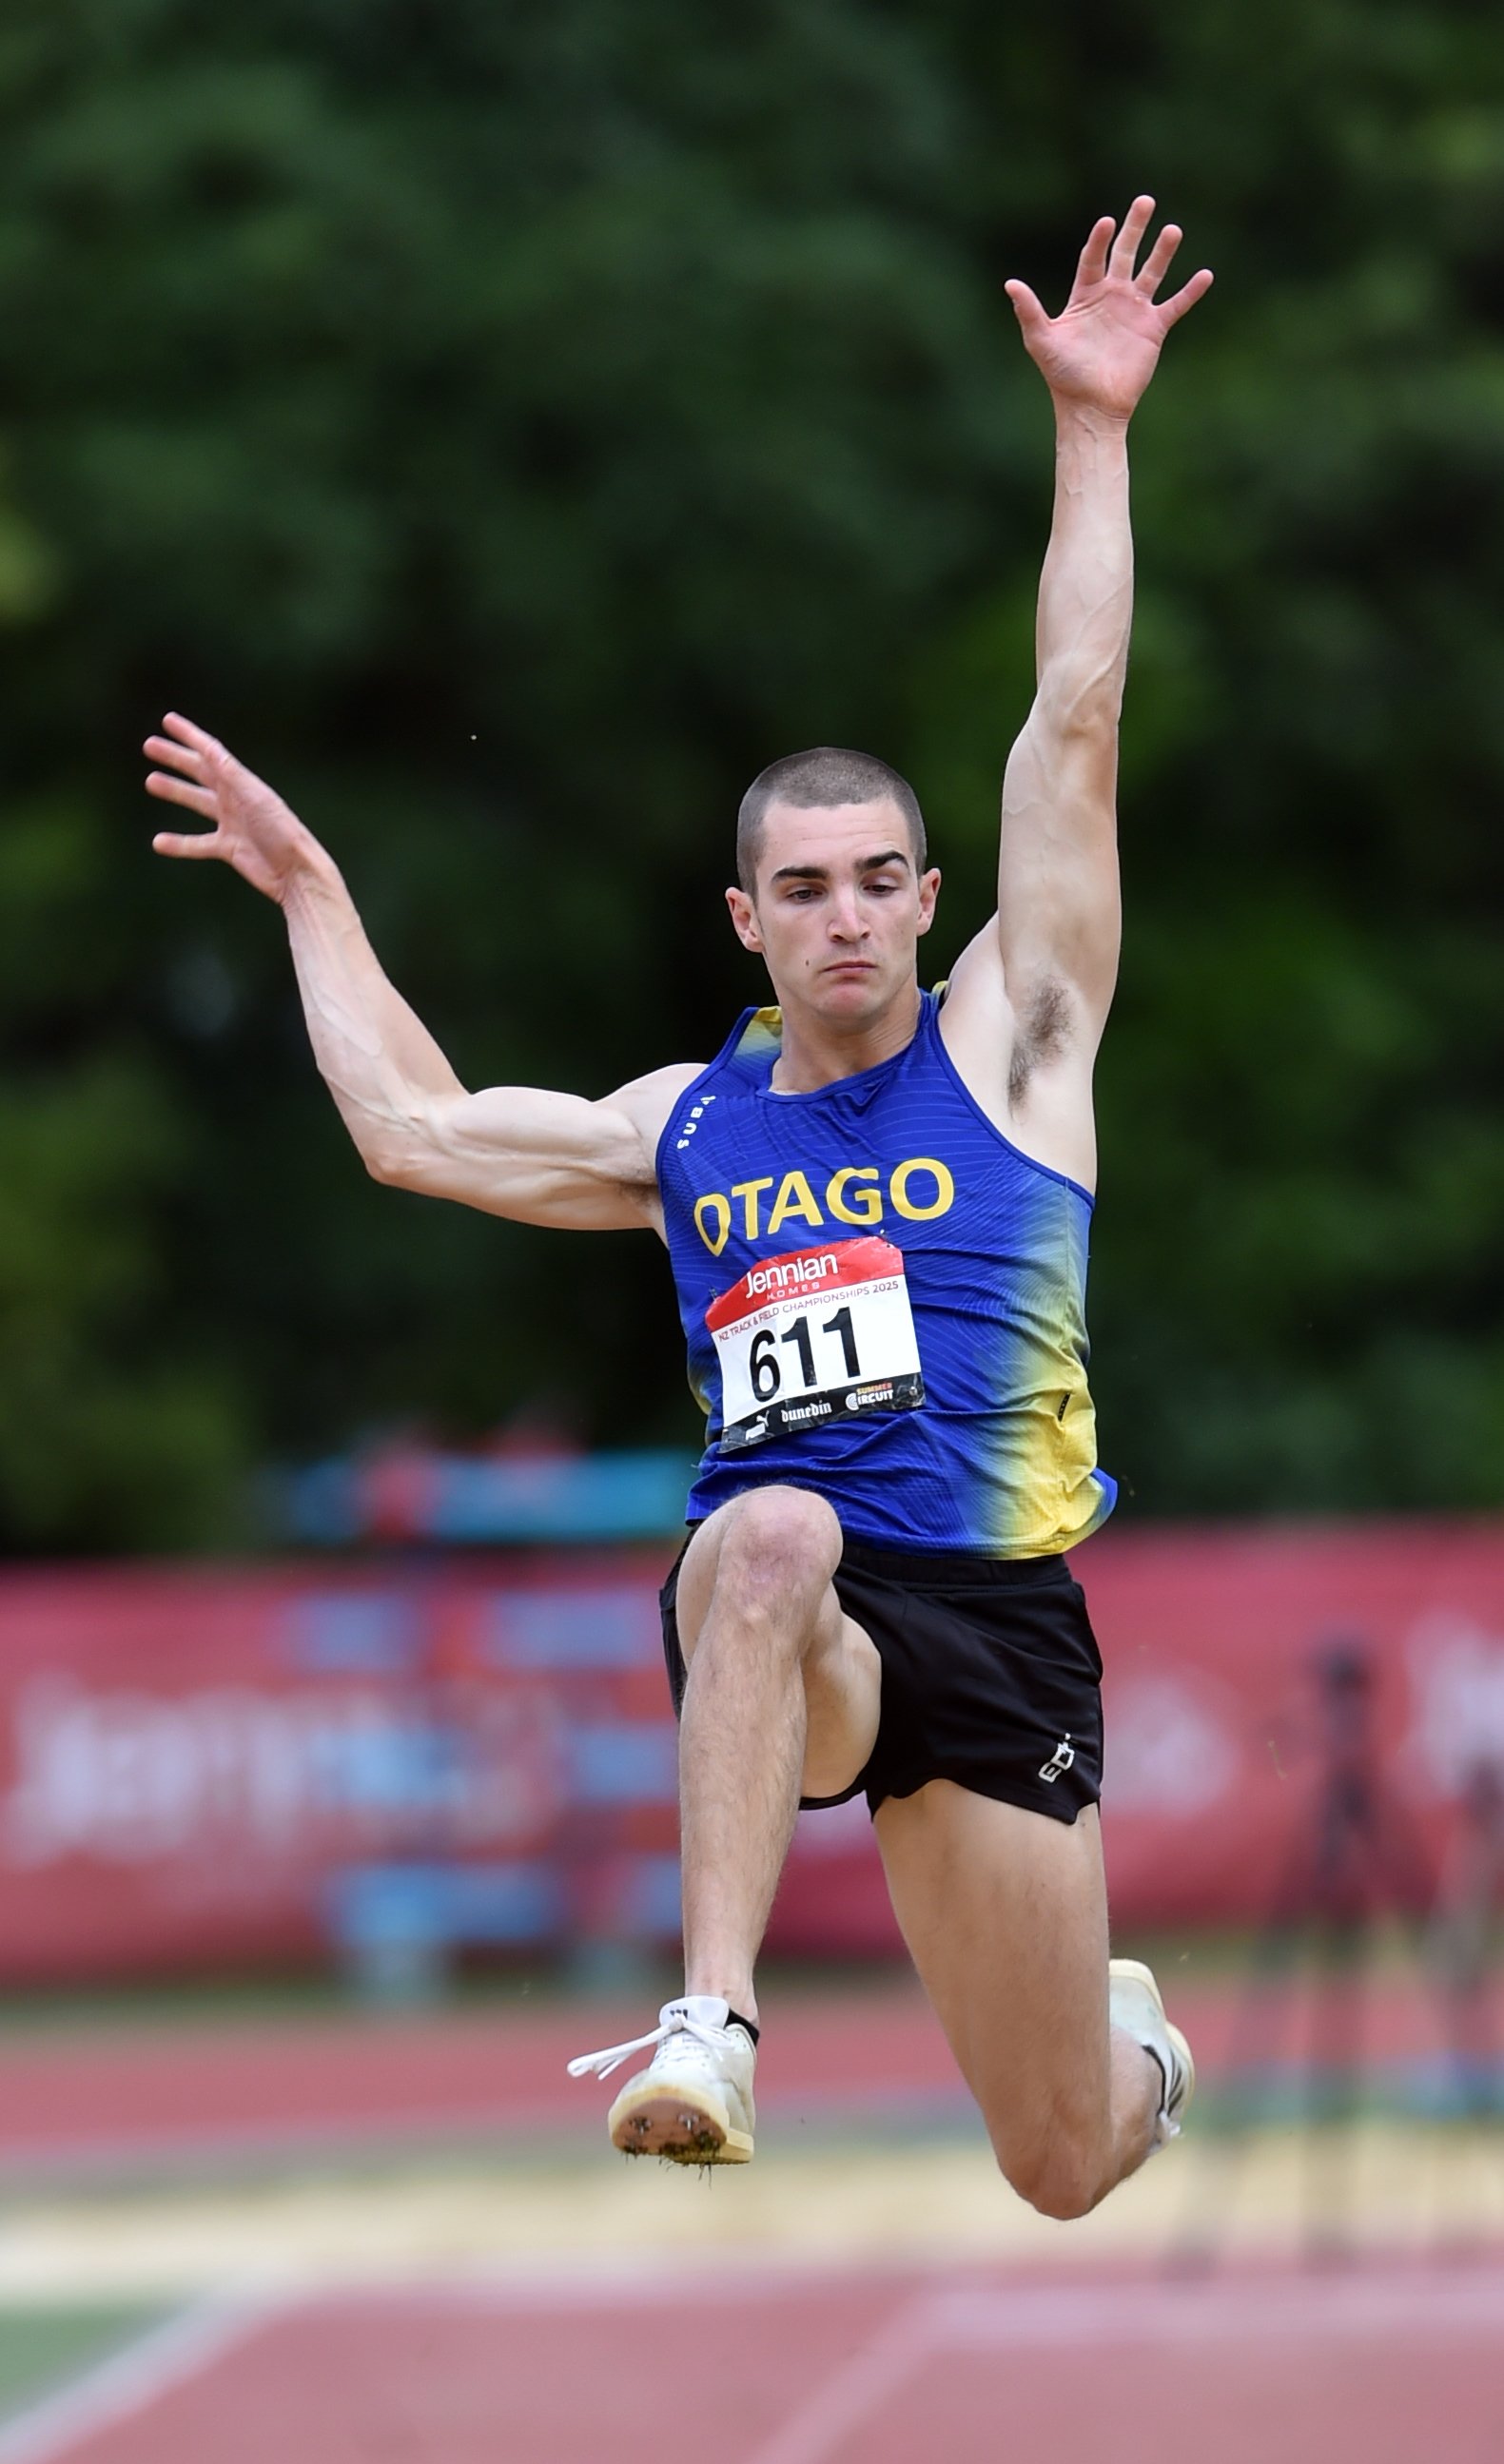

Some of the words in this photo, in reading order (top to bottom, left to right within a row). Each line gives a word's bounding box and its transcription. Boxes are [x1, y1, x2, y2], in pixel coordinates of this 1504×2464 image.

[693, 1157, 954, 1257] OTAGO
[746, 1253, 838, 1299] Jennian
[767, 1282, 820, 1300] HOMES
[730, 1320, 752, 1337] TRACK
[758, 1307, 780, 1323] FIELD
[782, 1287, 870, 1313] CHAMPIONSHIPS
[872, 1280, 899, 1294] 2025
[749, 1306, 861, 1403] 611
[780, 1399, 833, 1423] dunedin
